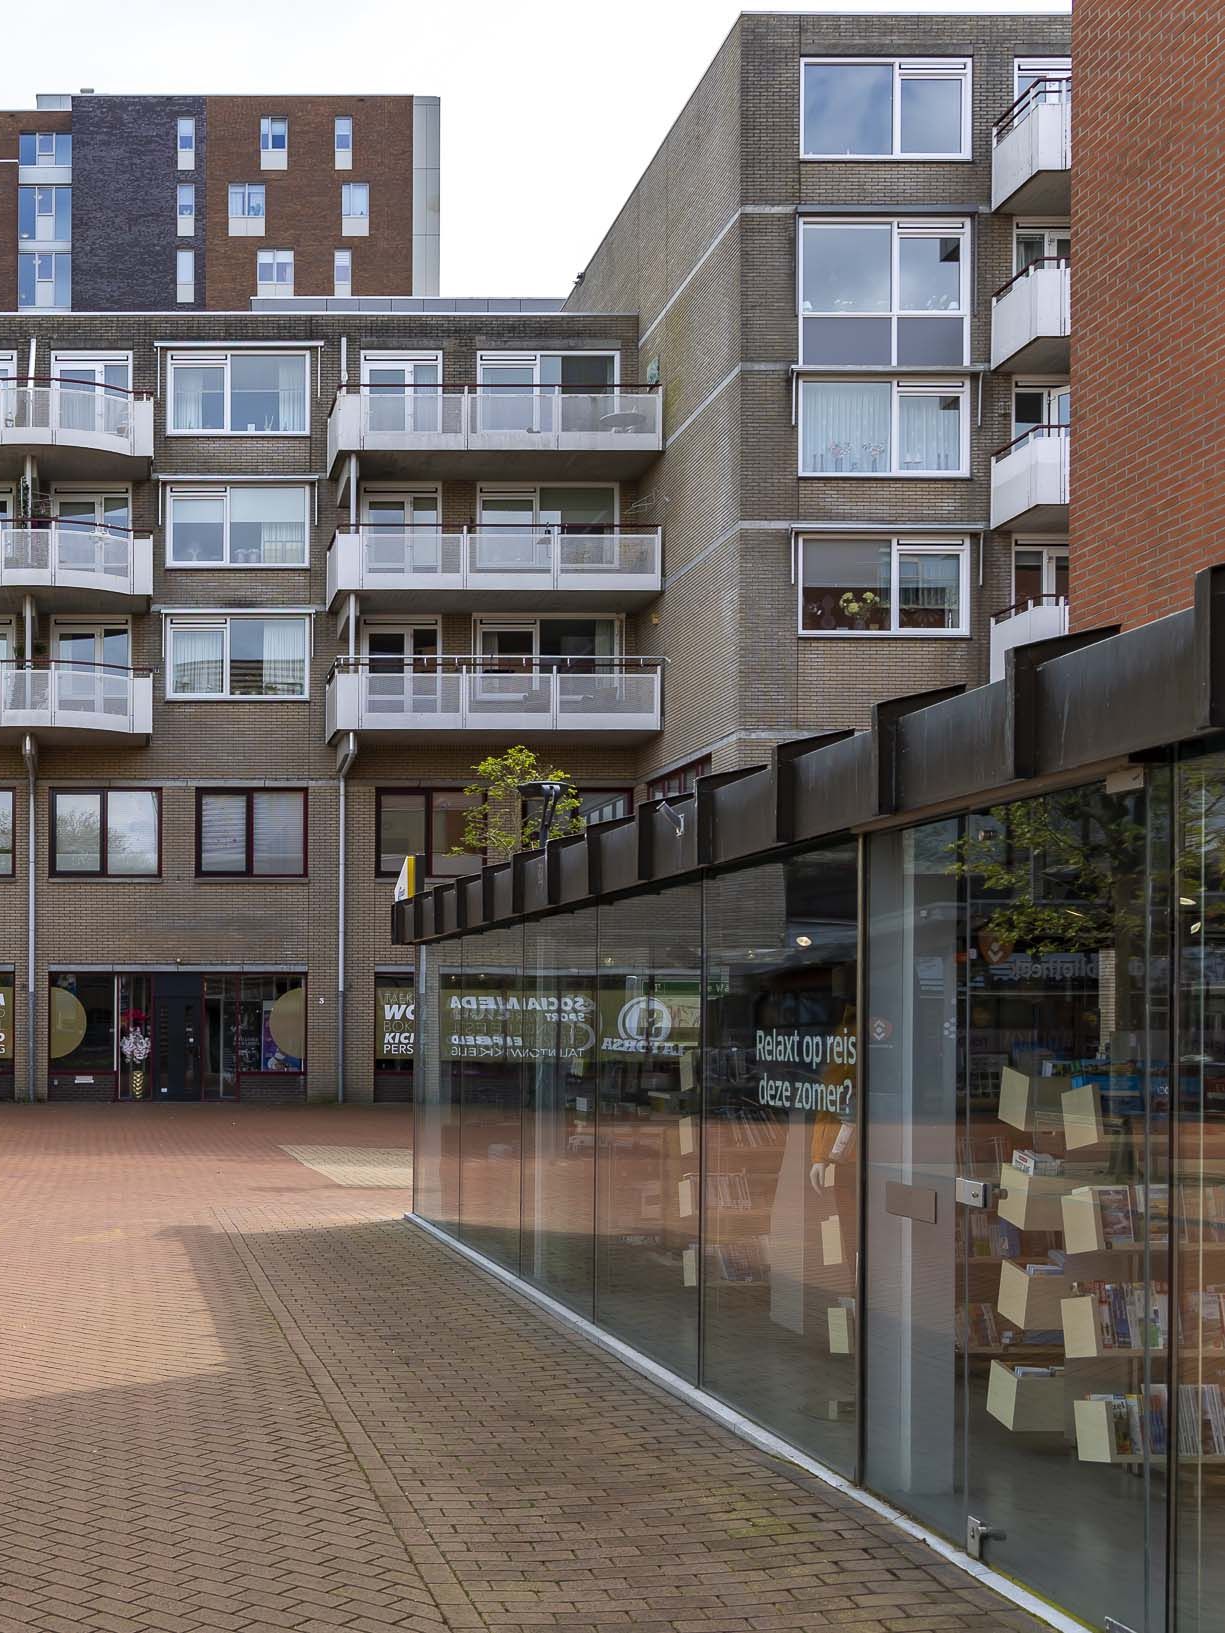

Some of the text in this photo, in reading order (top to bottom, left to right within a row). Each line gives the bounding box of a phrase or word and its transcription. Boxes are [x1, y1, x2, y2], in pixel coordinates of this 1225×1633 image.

[756, 1027, 857, 1069] Relaxt op reis
[759, 1072, 853, 1114] deze zomer?
